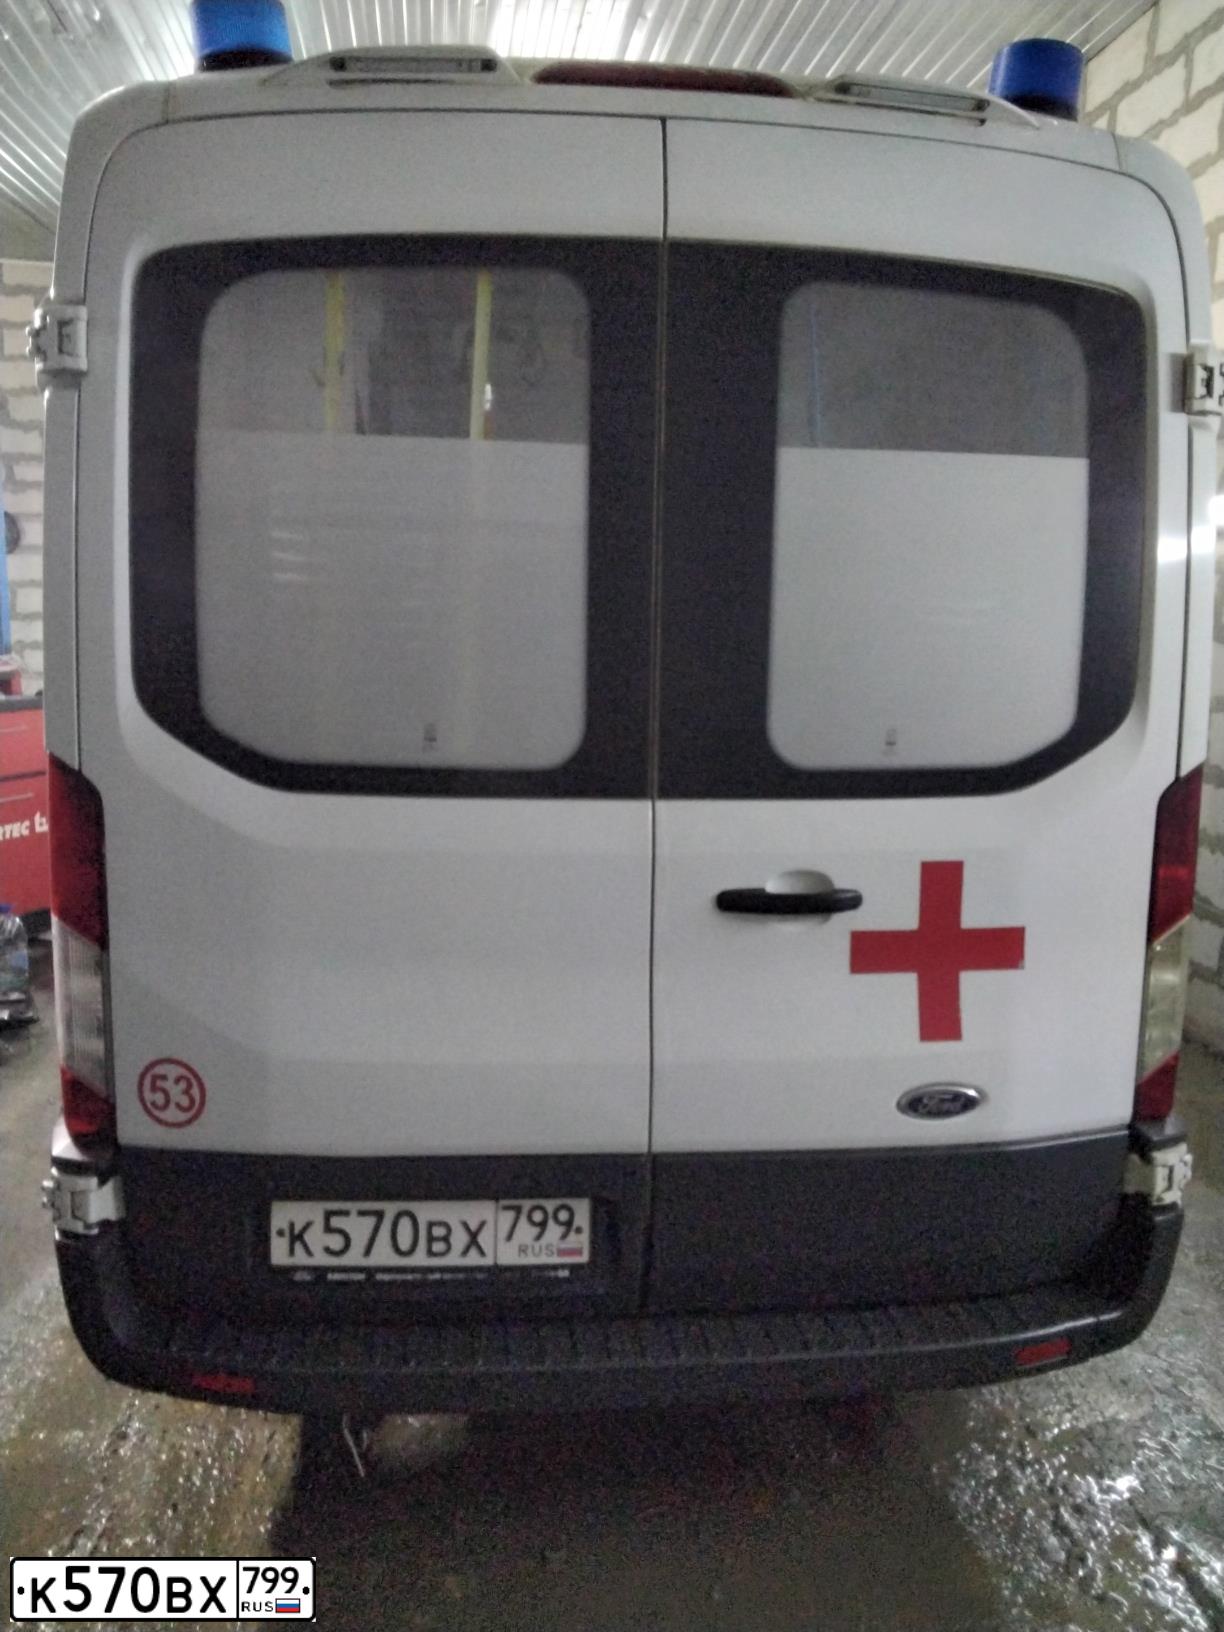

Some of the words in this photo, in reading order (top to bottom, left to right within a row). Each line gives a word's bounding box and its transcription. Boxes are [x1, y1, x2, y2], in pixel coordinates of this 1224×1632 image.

[150, 1074, 196, 1113] 53
[918, 1093, 967, 1114] Ford
[501, 1204, 576, 1242] 799
[518, 1243, 555, 1258] RUS
